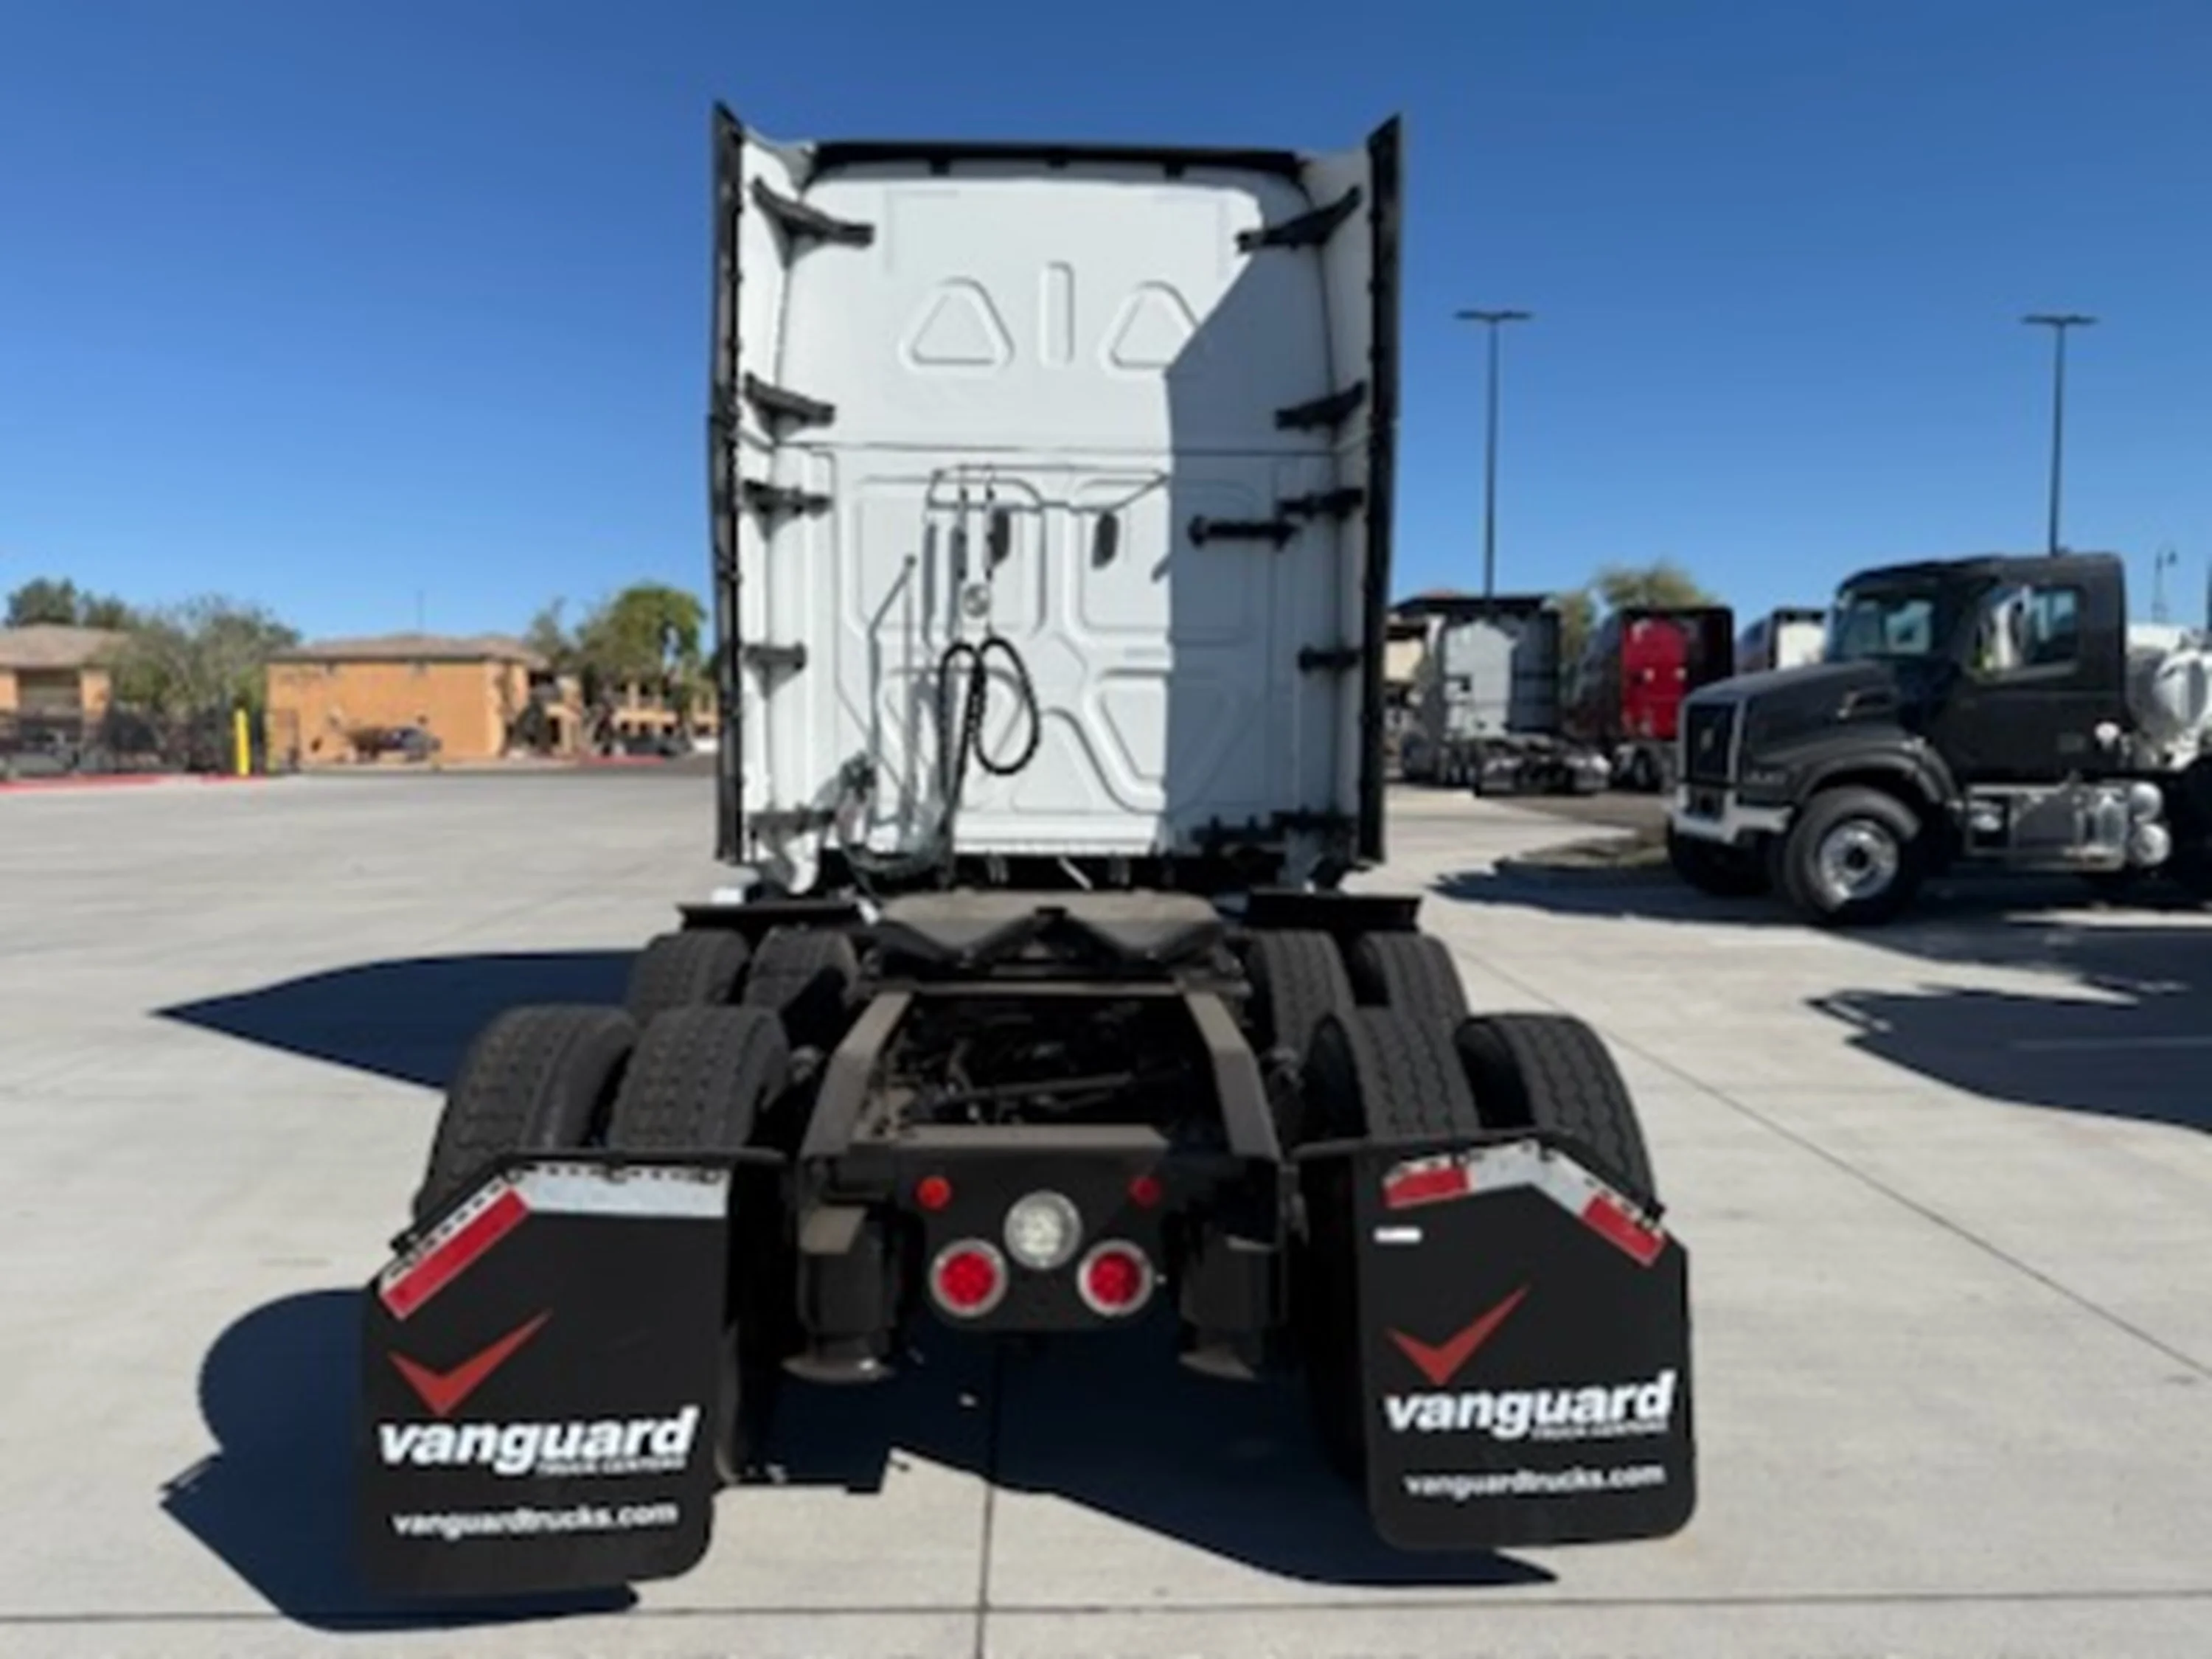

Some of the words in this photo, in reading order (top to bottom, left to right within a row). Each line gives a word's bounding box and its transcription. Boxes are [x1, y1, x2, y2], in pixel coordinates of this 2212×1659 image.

[1384, 1368, 1676, 1439] vanguard
[378, 1404, 700, 1475] vanguard
[1403, 1464, 1666, 1501] vanguardtrucks.com
[392, 1503, 679, 1542] vanguardtrucks.com
